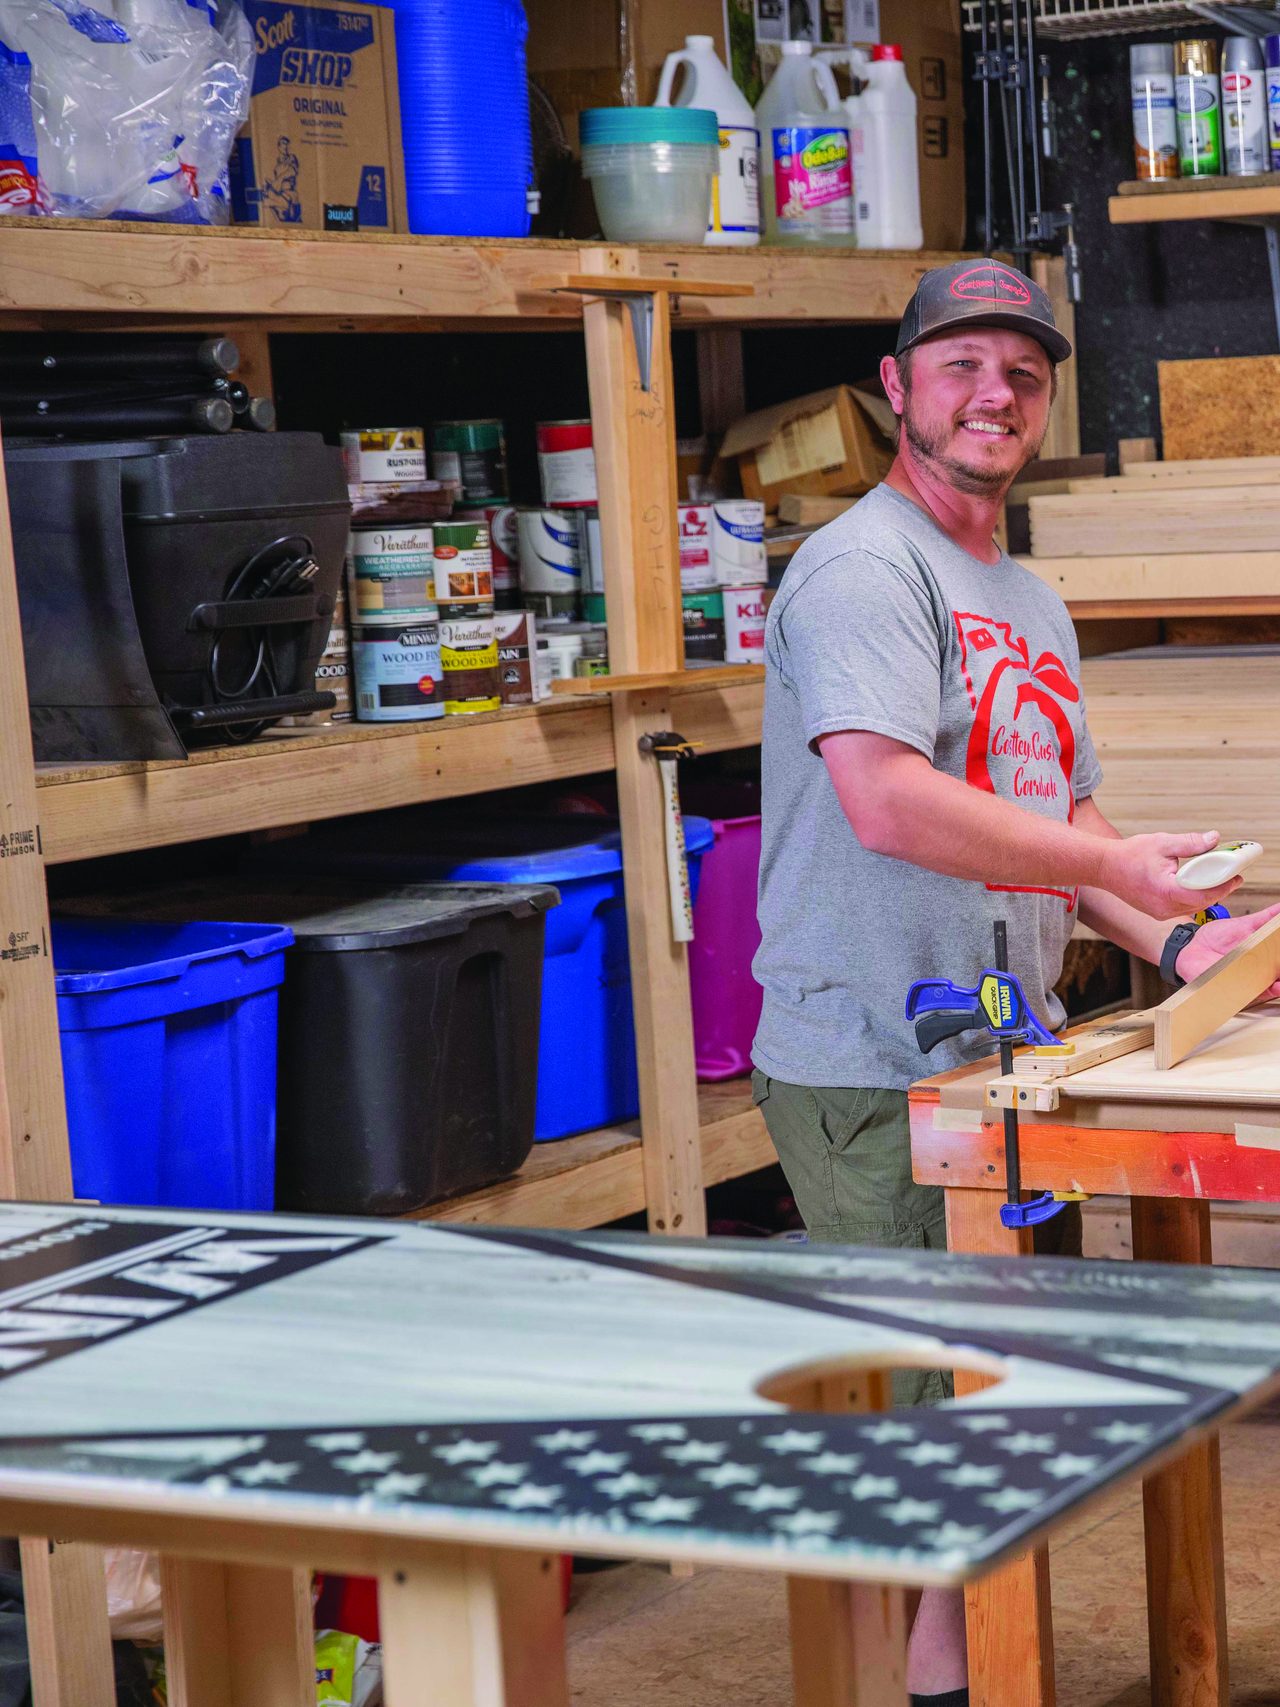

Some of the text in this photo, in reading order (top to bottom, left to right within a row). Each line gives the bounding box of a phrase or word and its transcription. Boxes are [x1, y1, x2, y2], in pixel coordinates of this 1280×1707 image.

[256, 10, 295, 54] Scott
[281, 50, 352, 88] SHOP
[293, 97, 347, 116] ORIGINAL
[366, 174, 381, 192] 12
[328, 207, 354, 224] prime
[738, 604, 766, 618] KIL
[382, 650, 440, 664] WOOD FIN
[441, 656, 477, 668] WOOD
[498, 649, 519, 660] AIN
[9, 830, 34, 845] PRIME
[1000, 985, 1011, 1022] IRWIN
